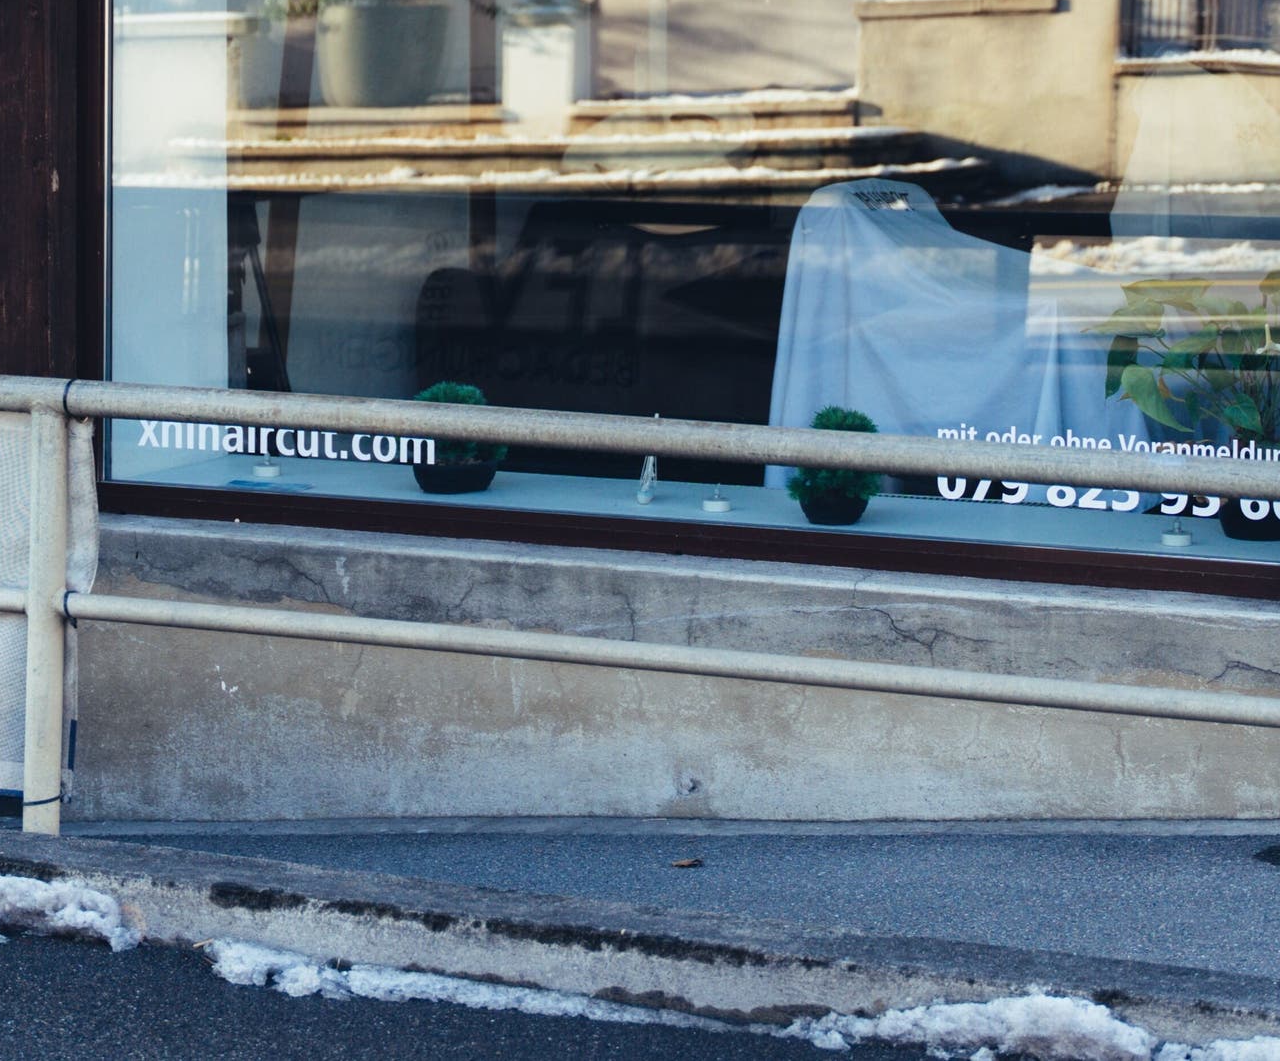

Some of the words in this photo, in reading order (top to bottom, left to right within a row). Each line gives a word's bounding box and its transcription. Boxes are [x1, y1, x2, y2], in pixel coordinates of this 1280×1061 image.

[937, 423, 978, 441] mit
[985, 425, 1043, 446] oder
[1050, 428, 1112, 450] ohne
